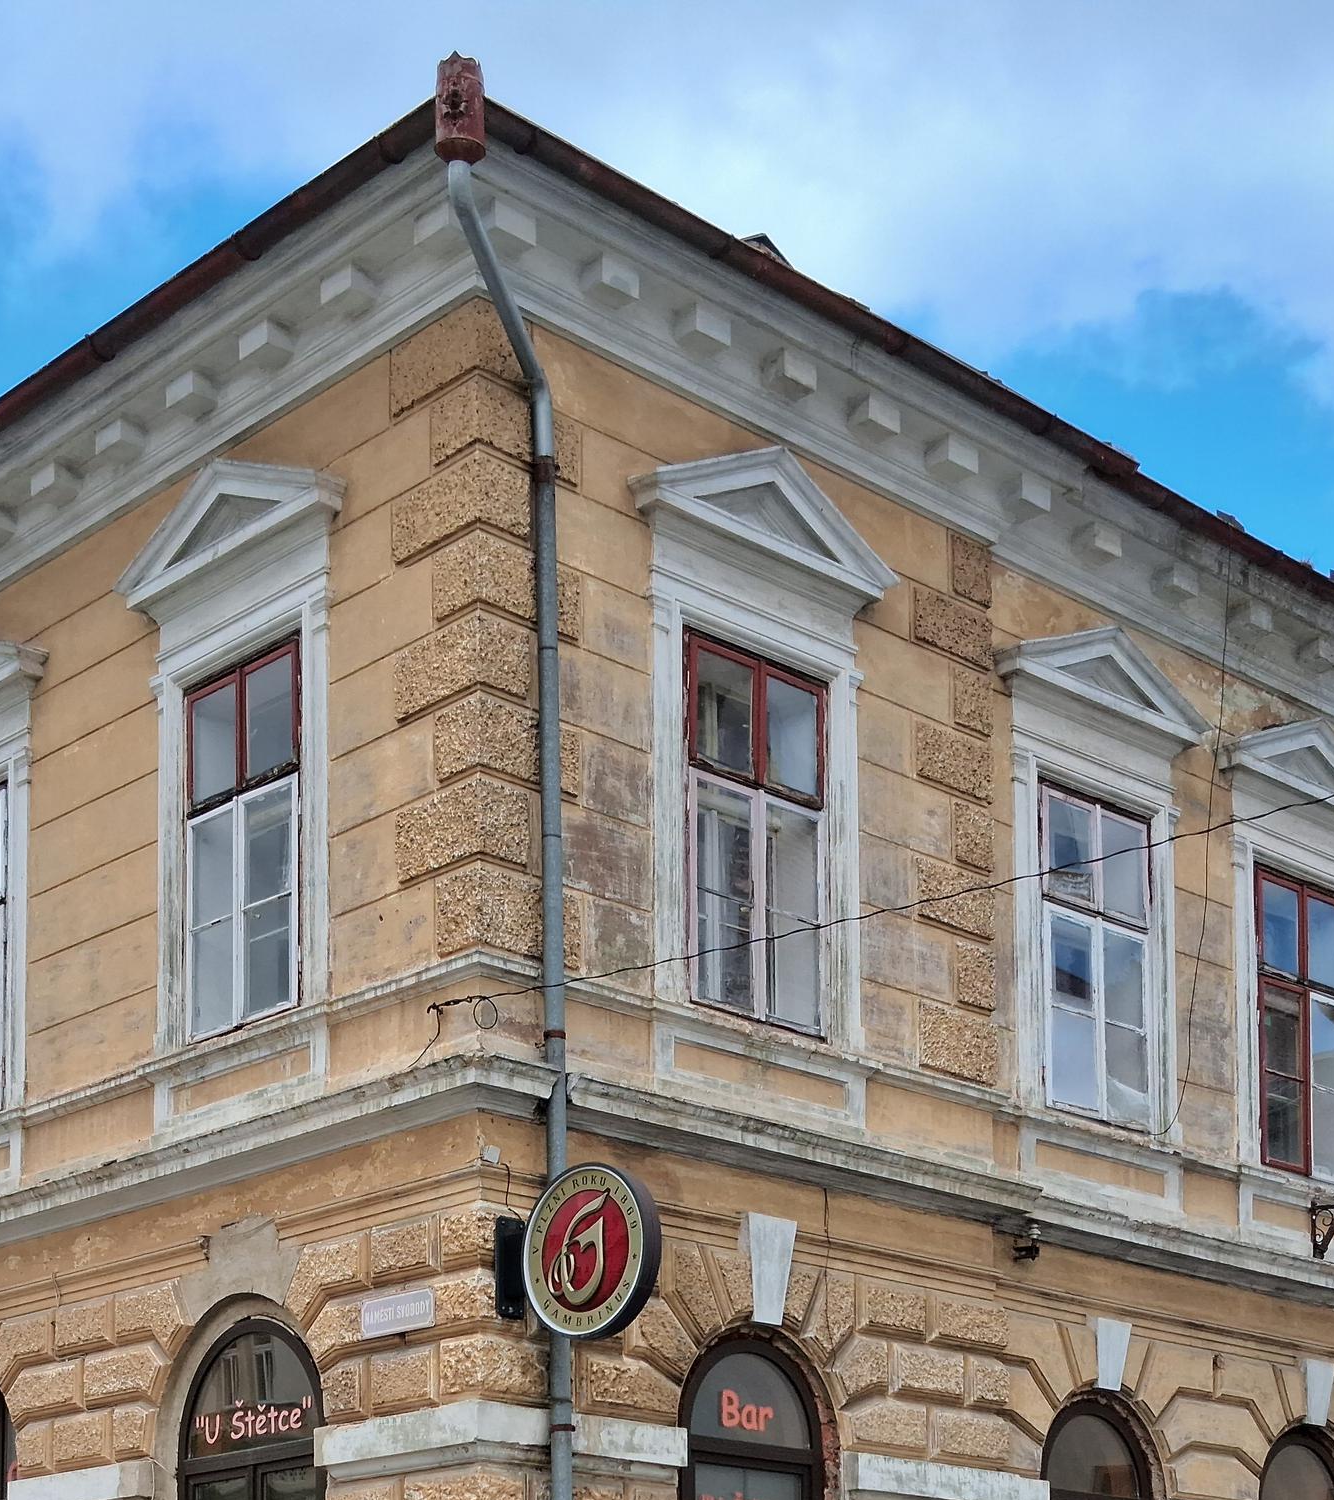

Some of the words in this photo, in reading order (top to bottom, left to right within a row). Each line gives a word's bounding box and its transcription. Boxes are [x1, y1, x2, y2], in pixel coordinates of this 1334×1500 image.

[536, 1188, 566, 1234] PLZNI
[571, 1174, 607, 1190] ROKU
[396, 1300, 431, 1319] SVOBODY
[543, 1279, 631, 1327] GAMBRINUS
[721, 1388, 774, 1432] Bar
